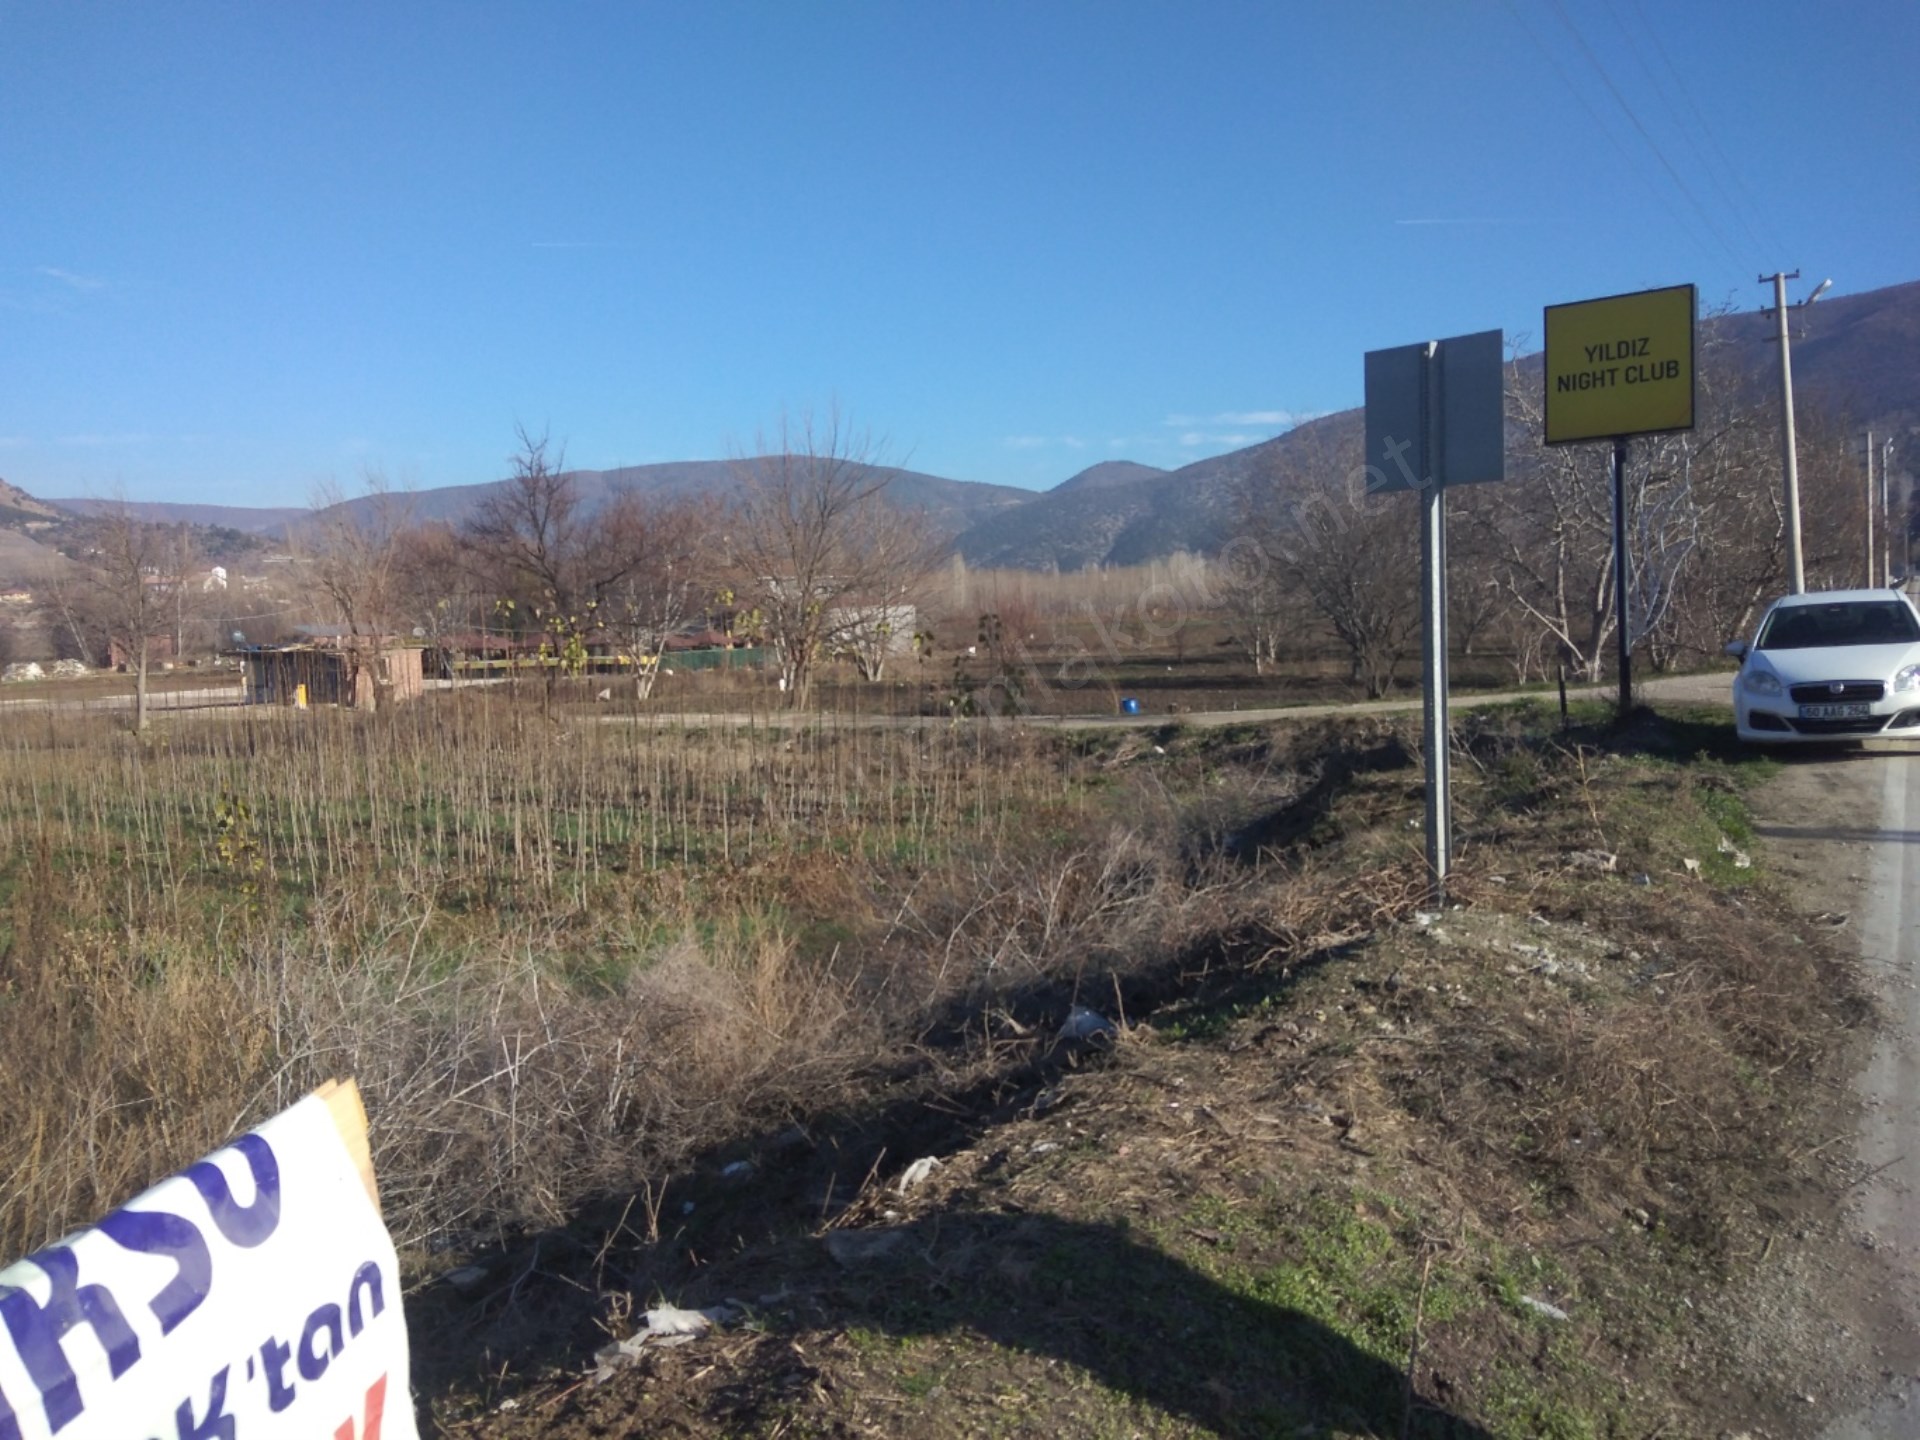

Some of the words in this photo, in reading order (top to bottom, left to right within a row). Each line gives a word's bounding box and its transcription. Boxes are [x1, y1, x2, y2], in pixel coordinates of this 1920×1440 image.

[1557, 368, 1619, 392] NIGHT
[1625, 360, 1679, 384] CLUB
[1585, 338, 1650, 363] YILDIZ
[0, 1133, 281, 1440] RSU
[150, 1261, 386, 1440] K'tan
